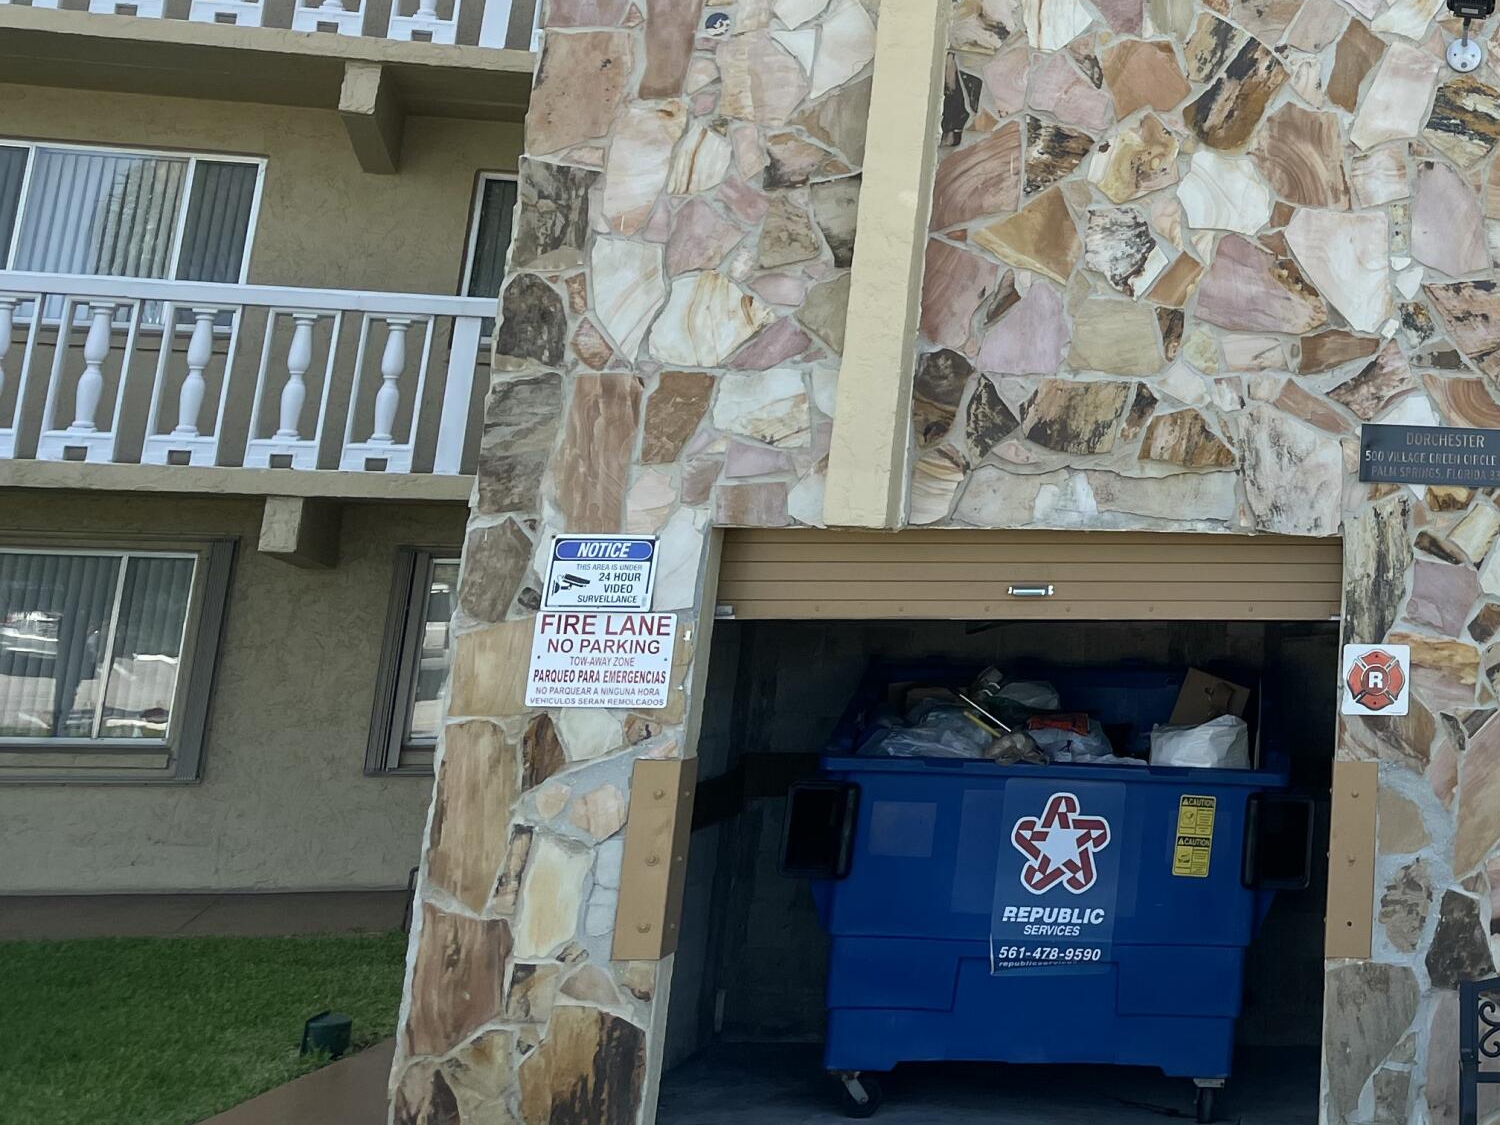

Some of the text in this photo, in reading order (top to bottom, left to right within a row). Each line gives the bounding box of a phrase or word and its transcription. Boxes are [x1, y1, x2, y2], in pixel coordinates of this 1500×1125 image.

[1406, 432, 1485, 448] DORCHESTER
[1365, 450, 1384, 462] 500
[1387, 451, 1426, 464] VILLAGE
[1429, 453, 1461, 465] GREEN
[1463, 454, 1497, 466] CIRCLE
[1371, 466, 1397, 476] PALM
[1446, 468, 1487, 480] FLORIDA
[577, 542, 632, 558] NOTICE
[598, 572, 641, 582] 24 HOUR
[604, 583, 633, 594] VIDEO
[577, 594, 638, 604] SURVEILLANCE
[540, 614, 672, 637] FIRE LANE
[547, 638, 661, 655] NO PARKING
[570, 656, 636, 667] TOW-AWAY ZONE
[533, 669, 667, 684] PARQUEO PARA EMERGENCIAS
[1368, 671, 1383, 689] R
[535, 686, 660, 697] NO PARQUEAR A NINGUNA HORA
[530, 697, 576, 705] VEHICULOS
[607, 698, 664, 706] REMOLCADOS
[1188, 799, 1214, 807] CAUTION
[1184, 838, 1210, 846] CAUTION
[1001, 906, 1105, 925] REPUBLIC
[1023, 925, 1081, 937] SERVICES
[998, 946, 1102, 962] 561-478-9590
